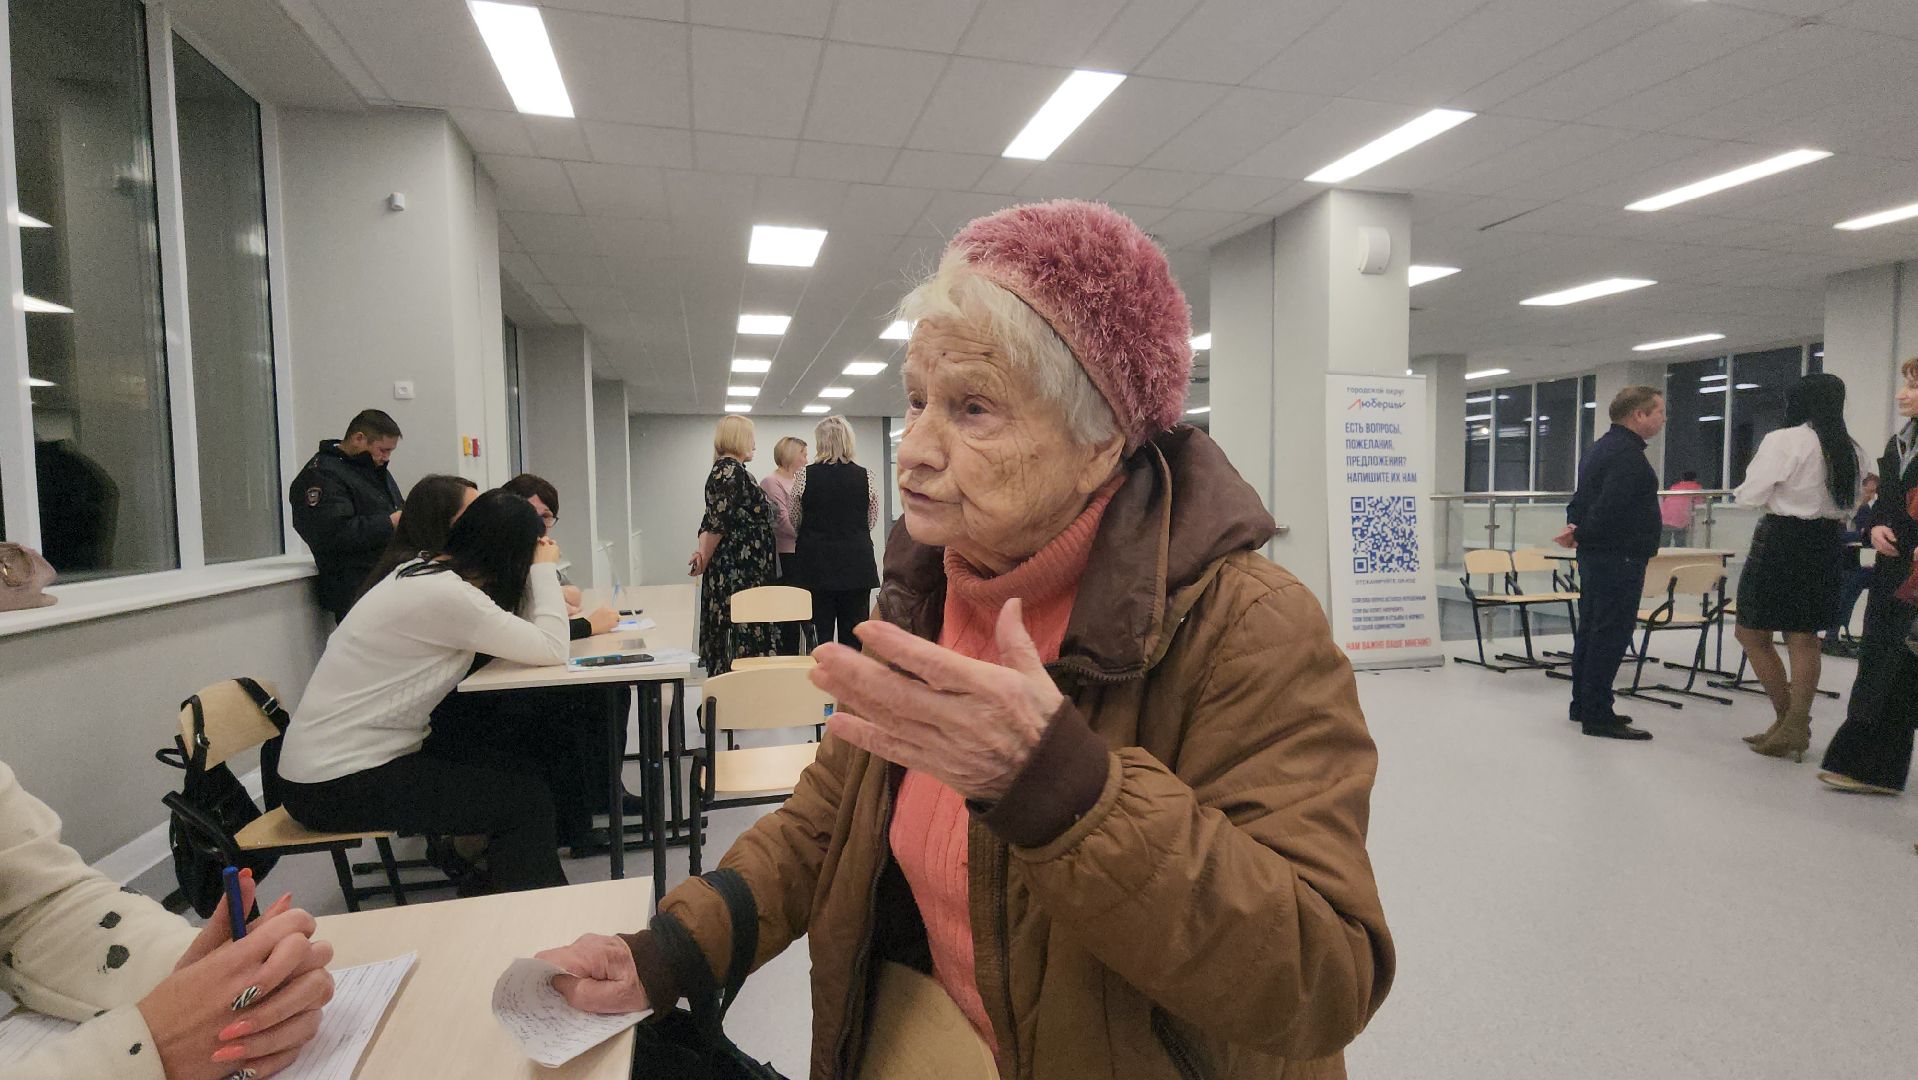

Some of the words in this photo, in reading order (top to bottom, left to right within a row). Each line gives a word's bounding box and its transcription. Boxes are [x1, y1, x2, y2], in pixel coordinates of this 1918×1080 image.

[1345, 422, 1364, 433] ЕСТЬ
[1346, 456, 1407, 467] ПРЕДЛОЖЕНИЯ?
[1347, 472, 1390, 483] НАПИШИТЕ
[1391, 472, 1401, 483] ИХ
[1402, 472, 1417, 482] НАМ
